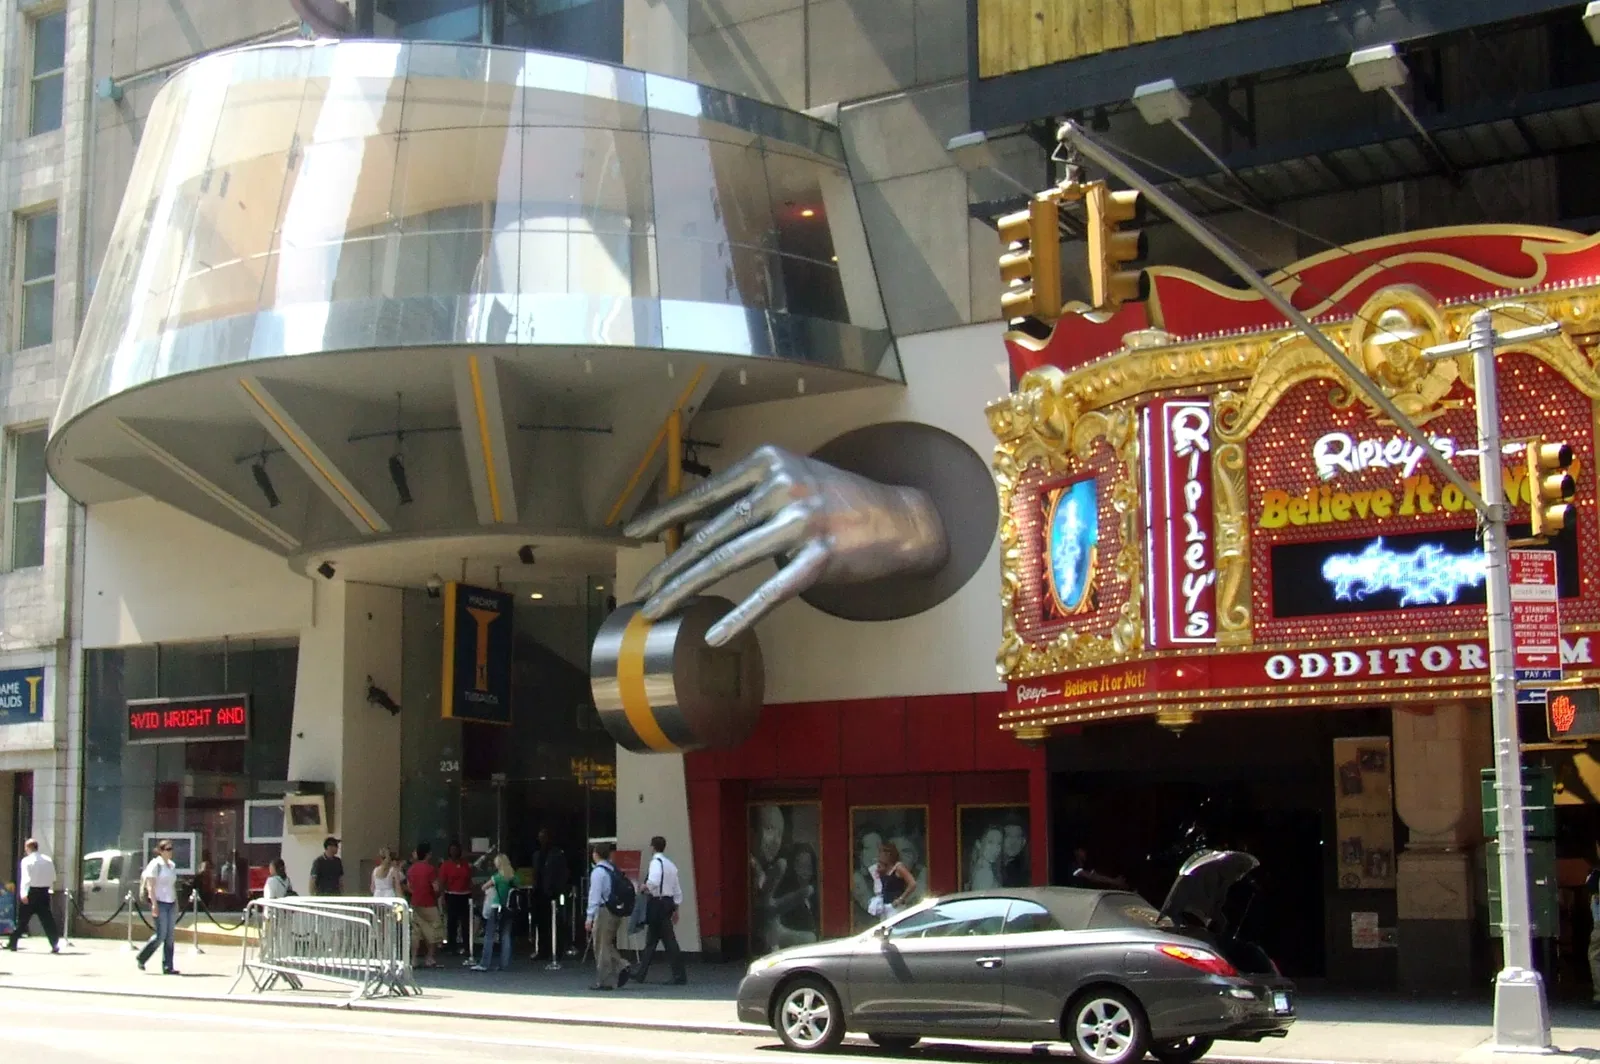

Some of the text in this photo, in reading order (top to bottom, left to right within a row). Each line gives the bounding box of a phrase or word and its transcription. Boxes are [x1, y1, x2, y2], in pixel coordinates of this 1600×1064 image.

[1313, 431, 1457, 481] Ripley's
[1258, 485, 1394, 529] Believe
[1399, 474, 1436, 516] It
[1172, 406, 1215, 637] Ripley's
[1522, 553, 1553, 561] STANDING
[1525, 605, 1555, 614] STANDING
[1521, 615, 1548, 623] EXCEPT
[1264, 637, 1592, 680] ODDITORM
[1064, 679, 1099, 698] Believe
[1100, 674, 1110, 692] It
[1111, 675, 1123, 691] or
[1124, 668, 1147, 689] Not!
[1524, 670, 1552, 679] PAY AT
[0, 682, 20, 695] AME
[163, 708, 212, 728] WRIGHT
[216, 706, 245, 725] AND
[439, 759, 459, 772] 234
